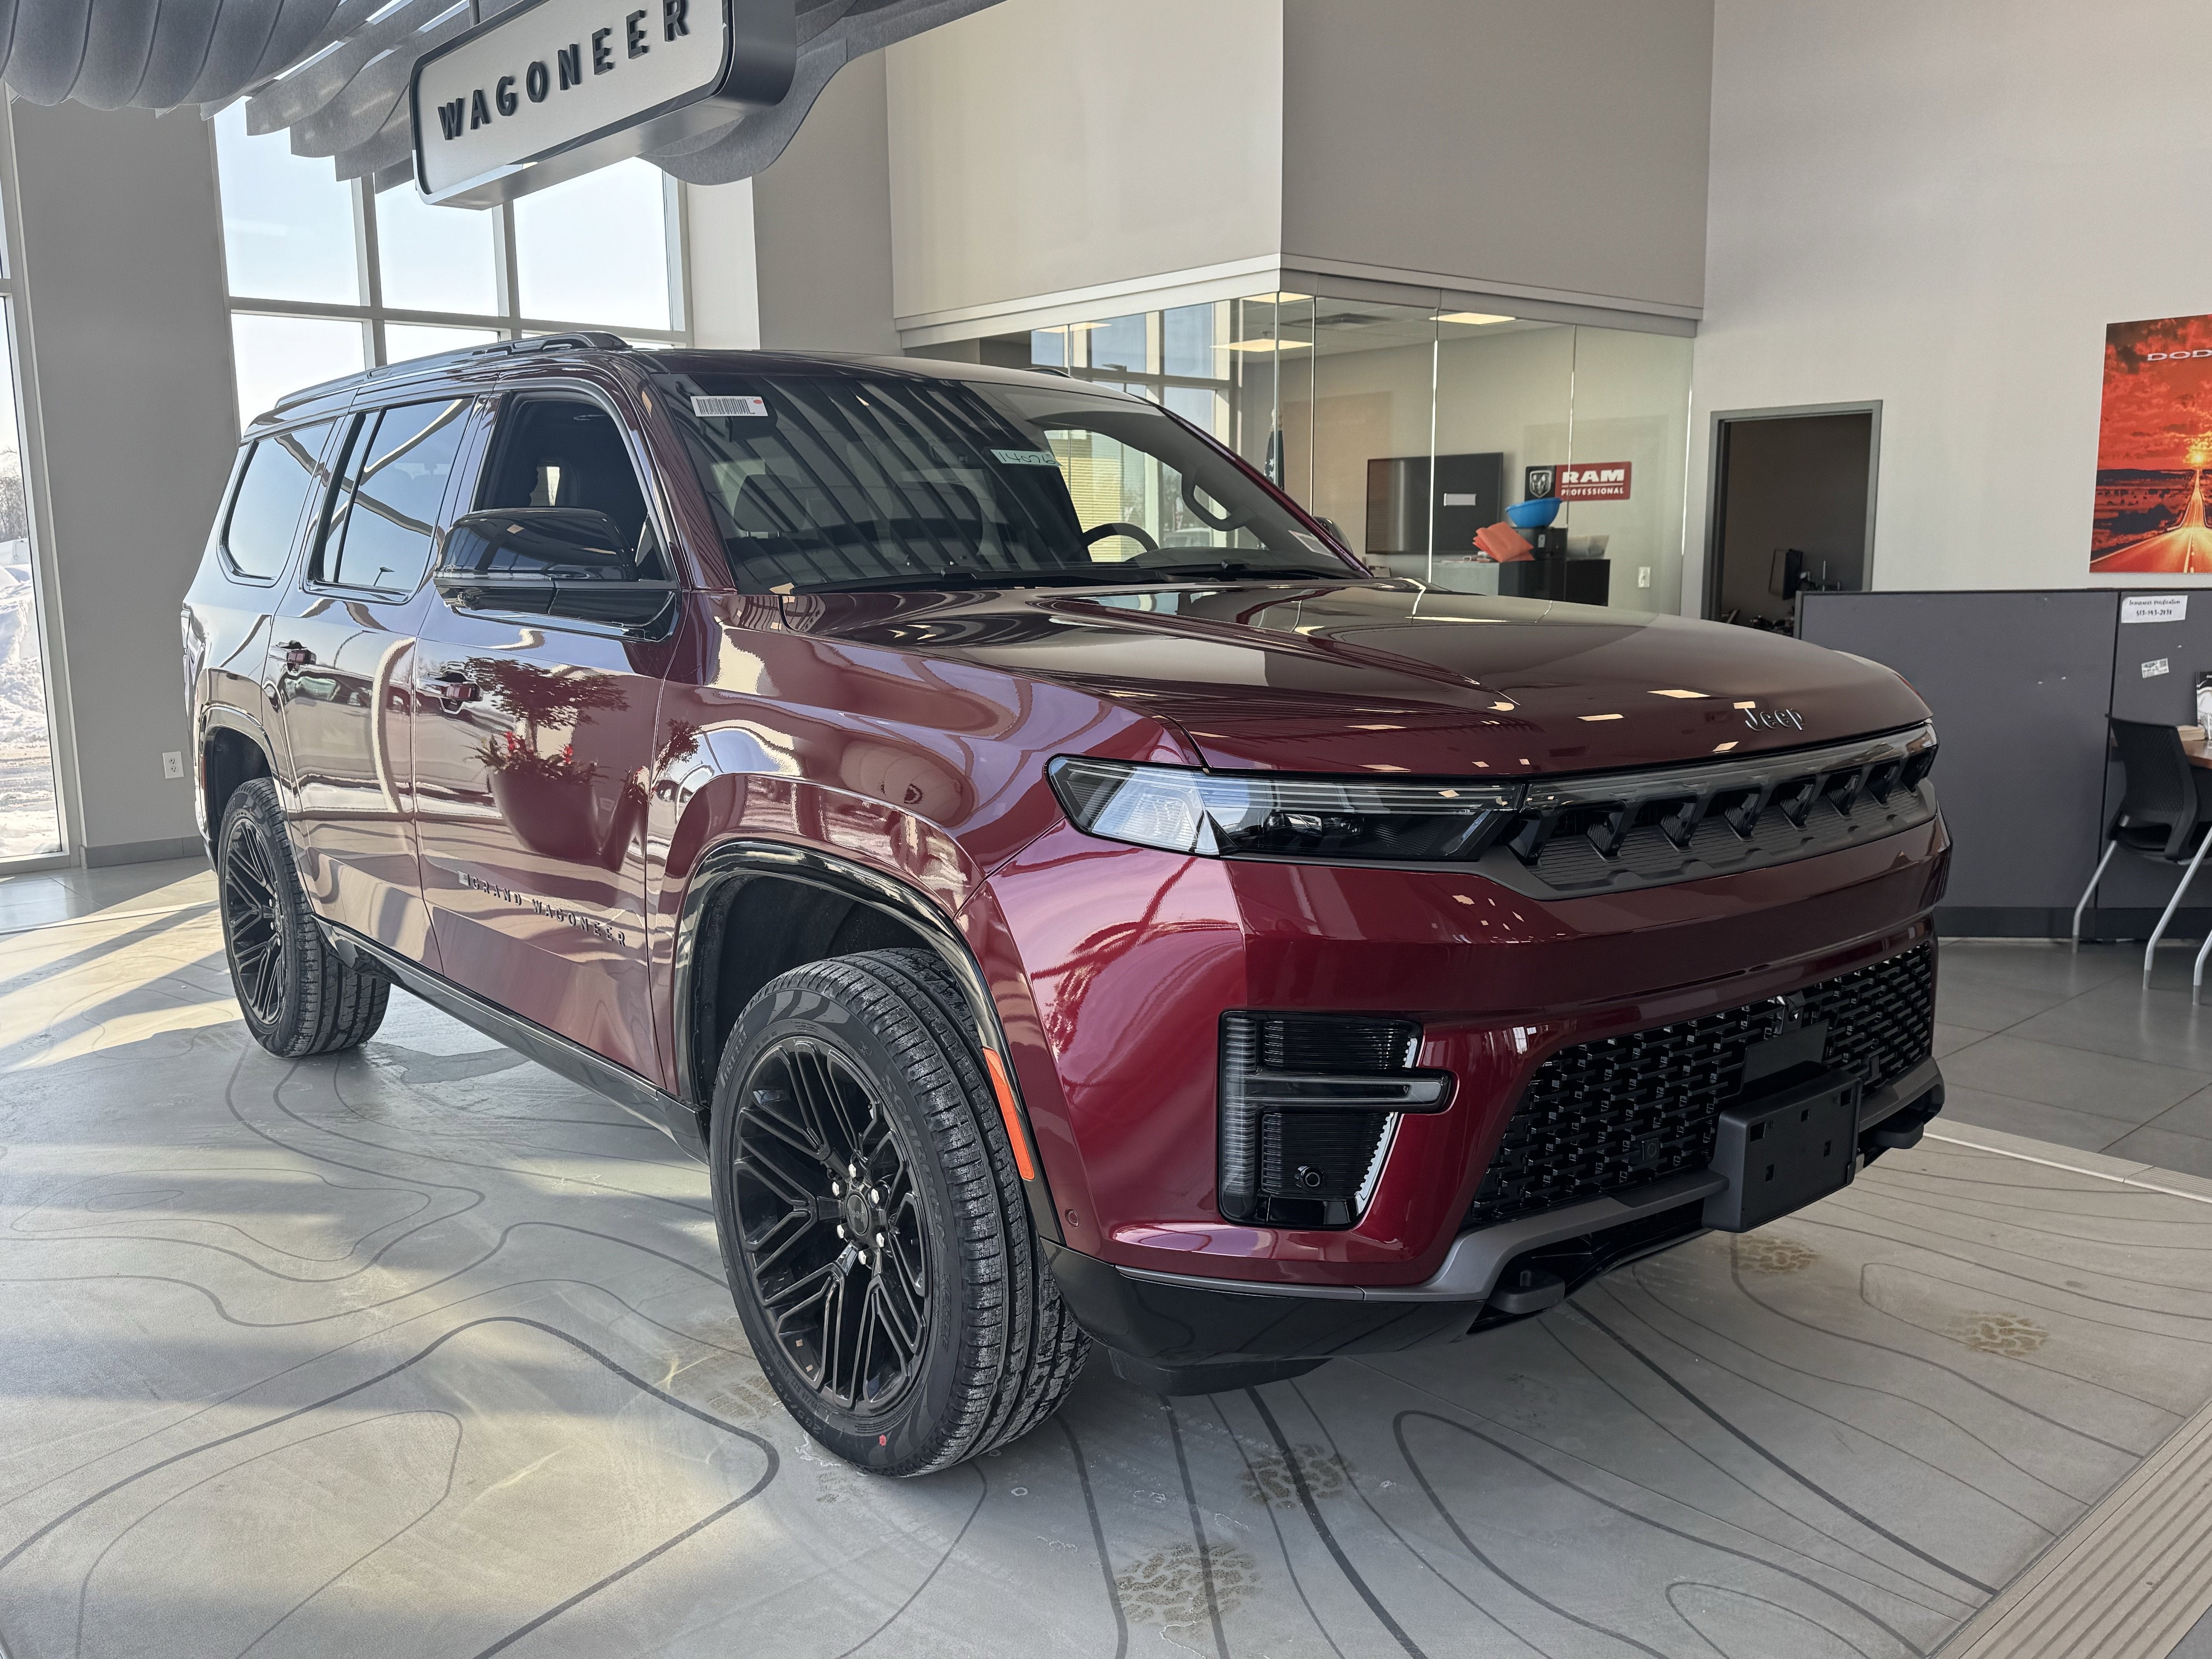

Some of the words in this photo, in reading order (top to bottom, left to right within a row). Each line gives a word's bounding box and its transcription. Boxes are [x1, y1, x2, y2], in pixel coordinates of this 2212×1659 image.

[438, 0, 690, 140] WAGONEER
[999, 452, 1056, 464] 14076
[1562, 469, 1625, 484] RAM
[1744, 708, 1805, 731] Jeep
[472, 876, 522, 906] GRAND
[532, 899, 626, 947] WAGONEER
